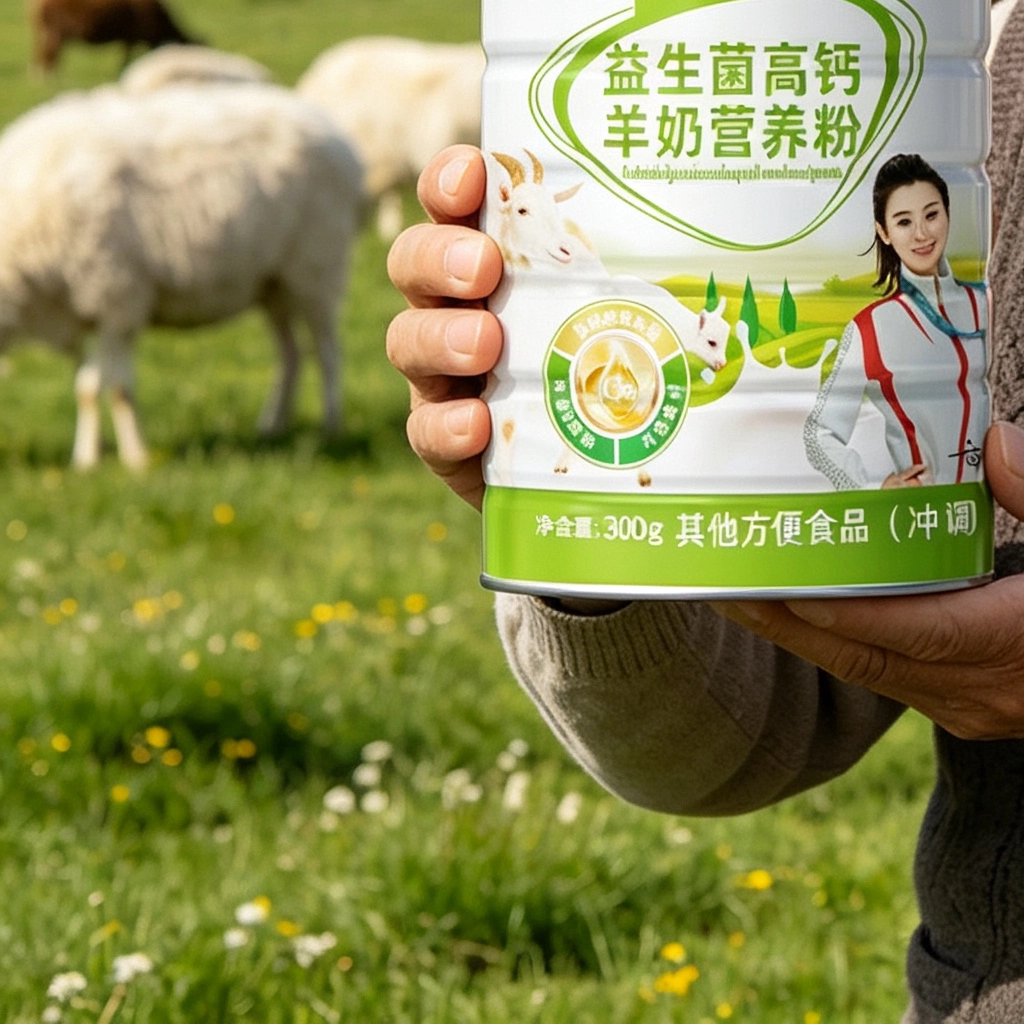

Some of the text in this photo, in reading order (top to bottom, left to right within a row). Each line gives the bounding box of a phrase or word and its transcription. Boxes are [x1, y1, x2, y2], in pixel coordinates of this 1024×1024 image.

[603, 41, 862, 96] 益生菌高钙
[603, 104, 862, 159] 羊奶营养粉
